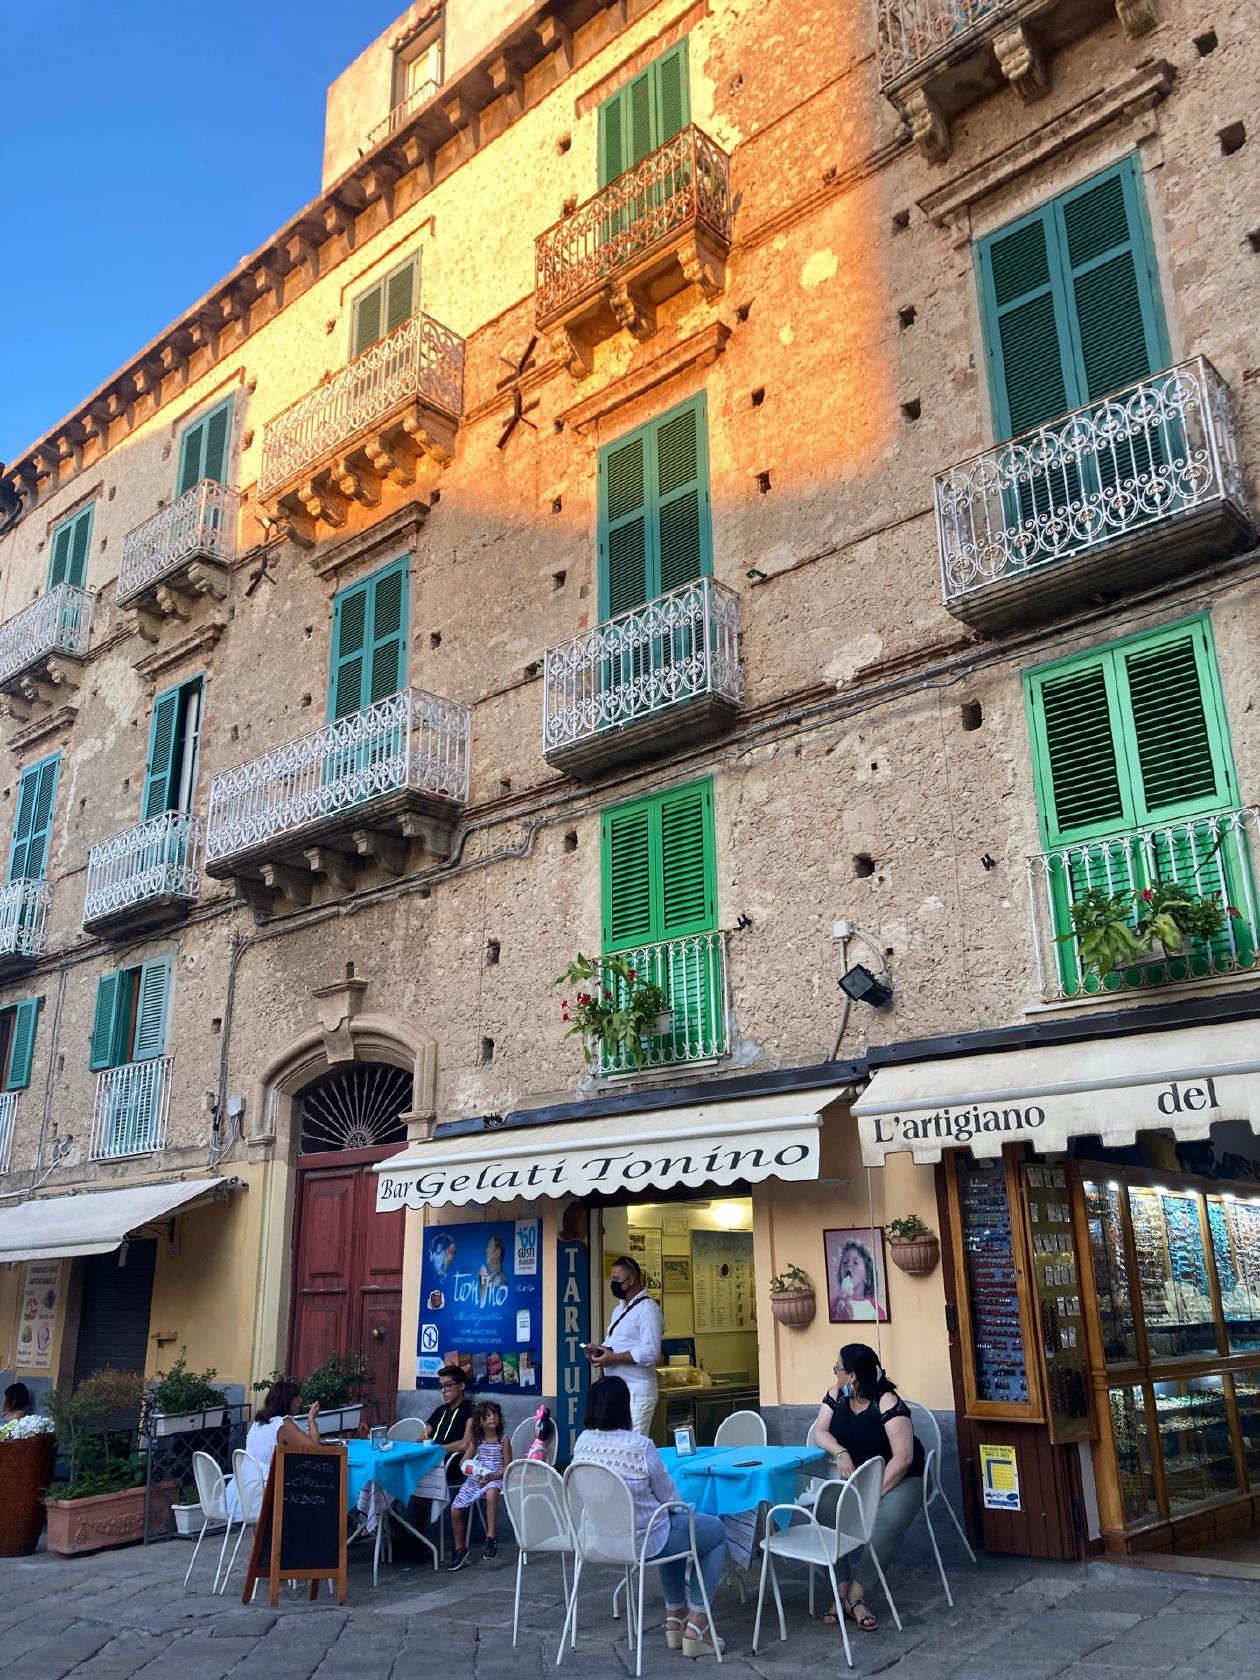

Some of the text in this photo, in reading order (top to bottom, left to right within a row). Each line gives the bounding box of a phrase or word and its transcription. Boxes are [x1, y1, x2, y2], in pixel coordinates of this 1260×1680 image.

[874, 1077, 1221, 1144] L'artigiano del
[381, 1144, 810, 1200] Bar Gelati Tonino
[517, 1247, 536, 1259] GUSTI
